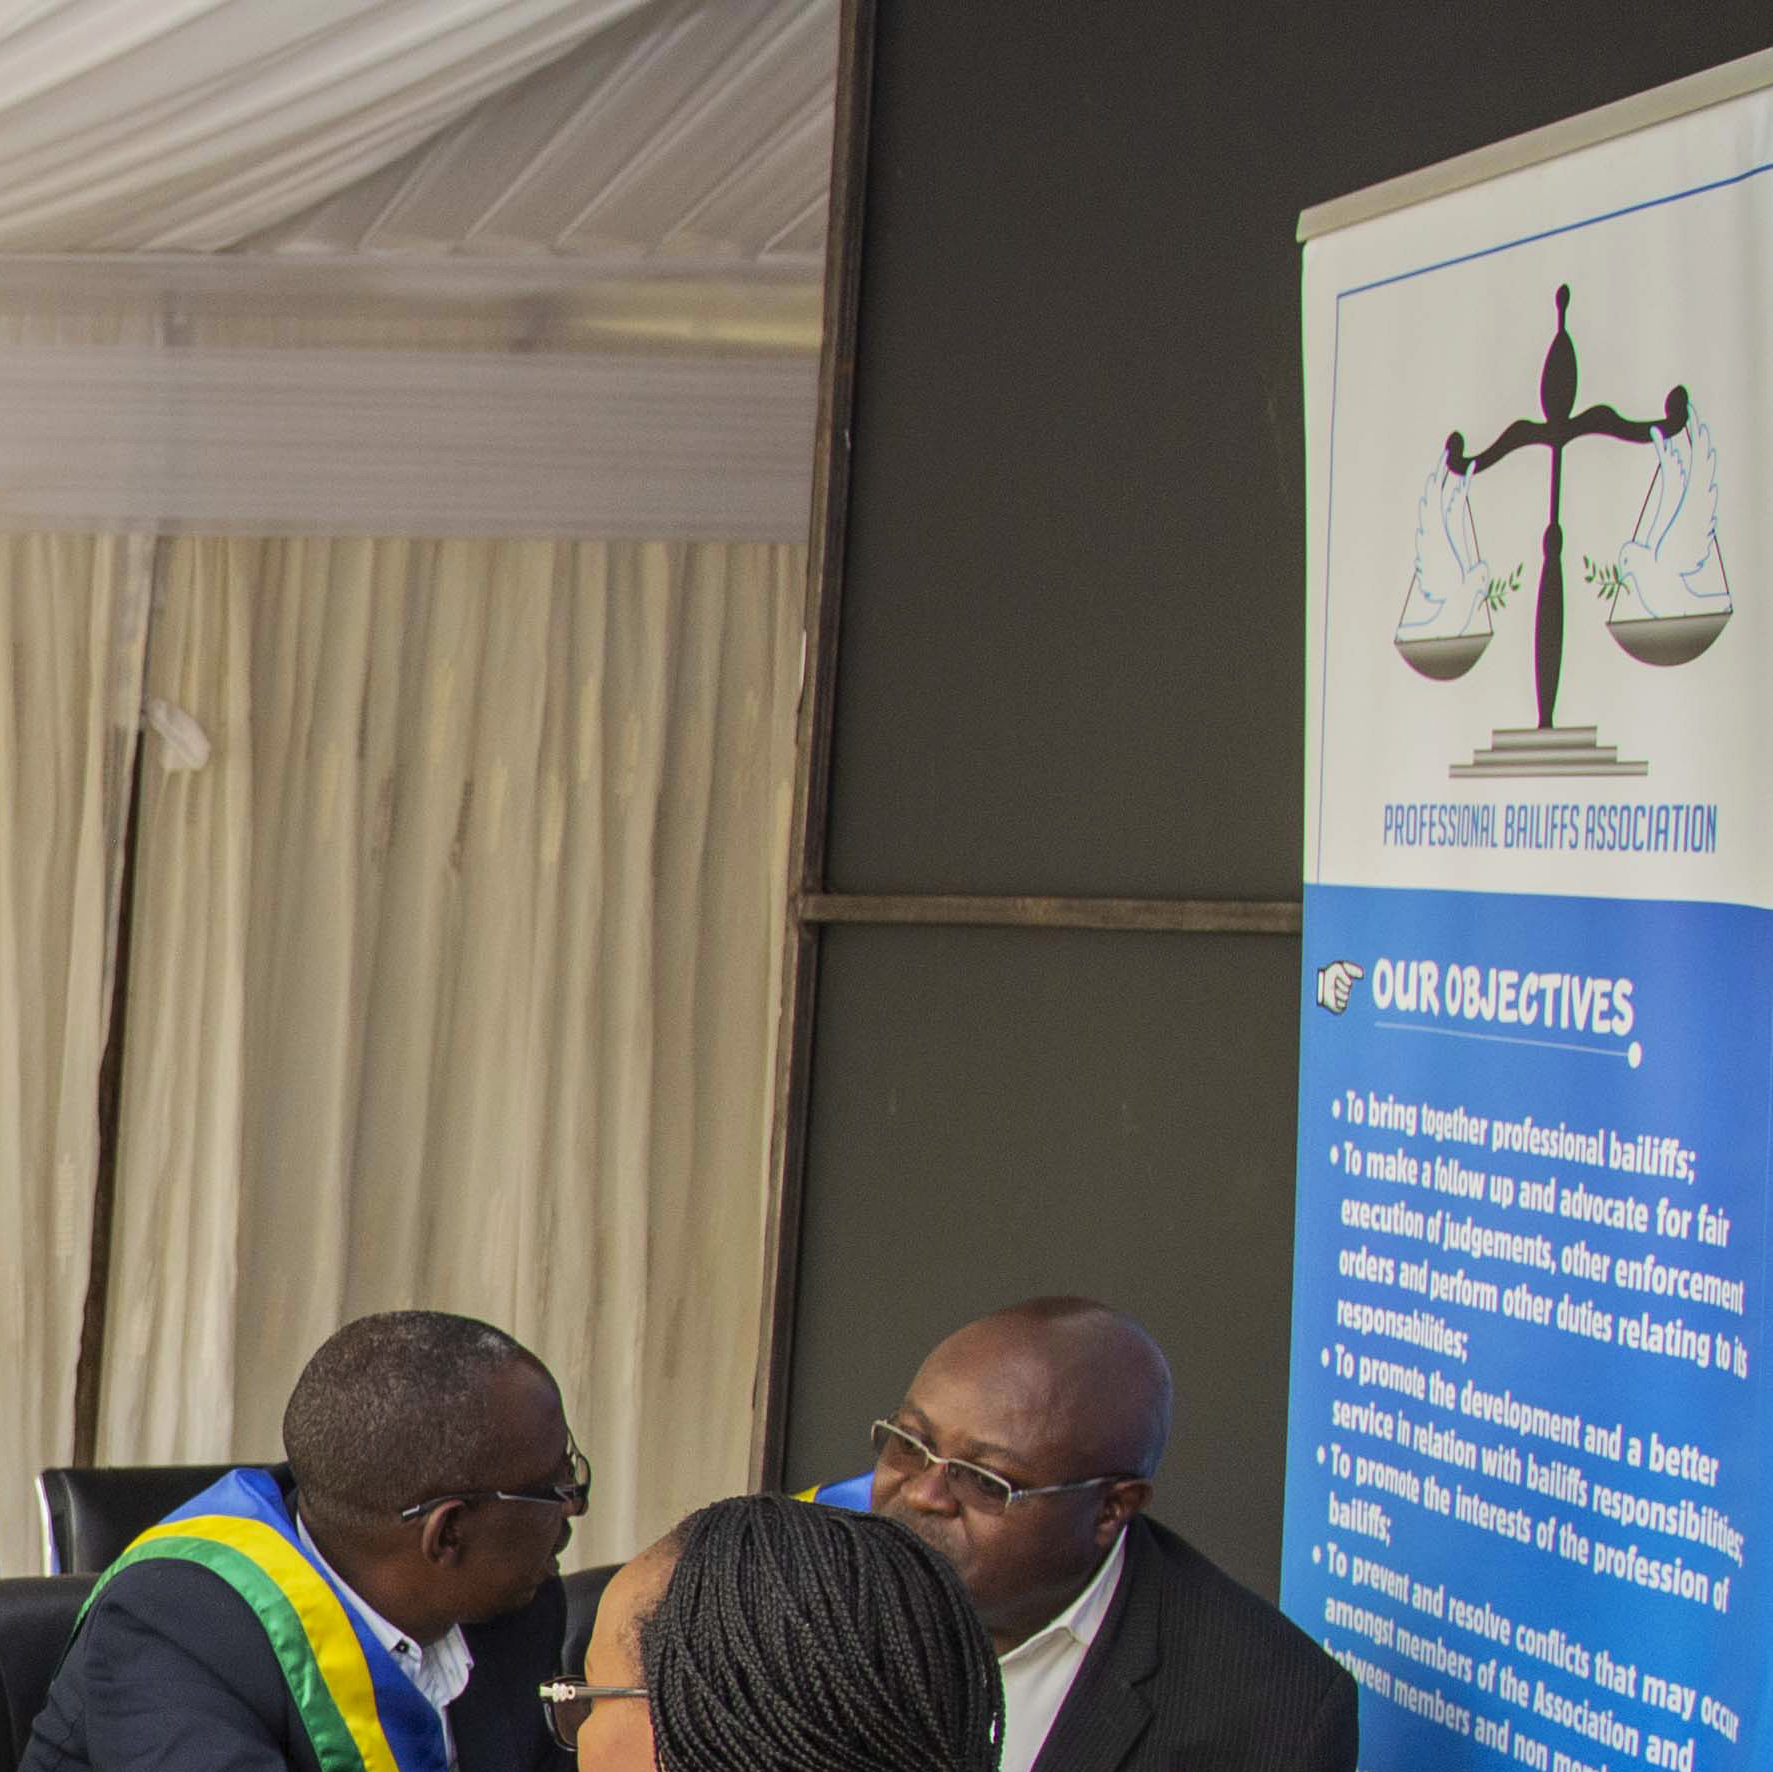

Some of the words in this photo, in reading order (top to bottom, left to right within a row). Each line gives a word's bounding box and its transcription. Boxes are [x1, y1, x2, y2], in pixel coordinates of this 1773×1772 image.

[1383, 804, 1498, 848] PROFESSIONAL
[1504, 803, 1580, 851] BAILIFFS
[1585, 803, 1717, 854] ASSOCIATION
[1373, 958, 1439, 1016] OUR
[1446, 963, 1634, 1036] OBJECTIVES
[1347, 1090, 1363, 1126] To
[1369, 1093, 1416, 1136] bring
[1421, 1104, 1487, 1148] together
[1493, 1115, 1604, 1160] professional
[1610, 1131, 1697, 1186] bailiffs;
[1344, 1142, 1361, 1175] To
[1367, 1150, 1417, 1185] make
[1422, 1162, 1431, 1187] a
[1434, 1157, 1484, 1200] follow
[1490, 1173, 1513, 1208] up
[1519, 1175, 1554, 1213] and
[1560, 1185, 1648, 1233] advocate
[1657, 1198, 1691, 1239] for
[1698, 1209, 1730, 1248] fair
[1341, 1199, 1423, 1241] execution
[1427, 1209, 1442, 1244] of
[1444, 1211, 1556, 1275] judgements,
[1561, 1240, 1611, 1281] other
[1615, 1253, 1744, 1315] enforcement
[1337, 1299, 1468, 1364] responsabilities;
[1339, 1249, 1394, 1286] orders
[1400, 1261, 1426, 1292] and
[1430, 1267, 1497, 1313] perform
[1503, 1281, 1552, 1326] other
[1557, 1294, 1612, 1343] duties
[1618, 1311, 1709, 1370] relating
[1716, 1333, 1730, 1370] to
[1733, 1339, 1748, 1379] its
[1332, 1398, 1393, 1442] service
[1398, 1409, 1410, 1444] in
[1414, 1413, 1476, 1469] relation
[1482, 1436, 1521, 1486] with
[1527, 1449, 1587, 1510] bailiffs
[1335, 1343, 1353, 1378] To
[1359, 1352, 1425, 1399] promote
[1429, 1370, 1455, 1410] the
[1461, 1380, 1580, 1450] development
[1586, 1418, 1621, 1463] and
[1627, 1434, 1641, 1467] a
[1650, 1433, 1718, 1487] better
[1330, 1492, 1391, 1548] bailiffs;
[1331, 1444, 1350, 1477] To
[1355, 1456, 1419, 1504] promote
[1424, 1473, 1450, 1515] the
[1456, 1484, 1531, 1546] interests
[1537, 1512, 1555, 1552] of
[1560, 1520, 1589, 1565] the
[1594, 1538, 1708, 1609] profession
[1714, 1576, 1730, 1614] of
[1325, 1597, 1393, 1647] amongst
[1397, 1626, 1472, 1683] members
[1478, 1652, 1495, 1689] of
[1500, 1661, 1529, 1706] the
[1533, 1682, 1638, 1757] Association
[1328, 1543, 1346, 1577] To
[1353, 1550, 1408, 1604] prevent
[1412, 1571, 1443, 1617] and
[1450, 1587, 1510, 1646] resolve
[1516, 1610, 1590, 1680] conflicts
[1595, 1647, 1635, 1698] that
[1643, 1675, 1695, 1723] may
[1701, 1693, 1739, 1744] occur
[1395, 1677, 1470, 1734] members
[1475, 1710, 1508, 1754] and
[1514, 1733, 1547, 1772] non
